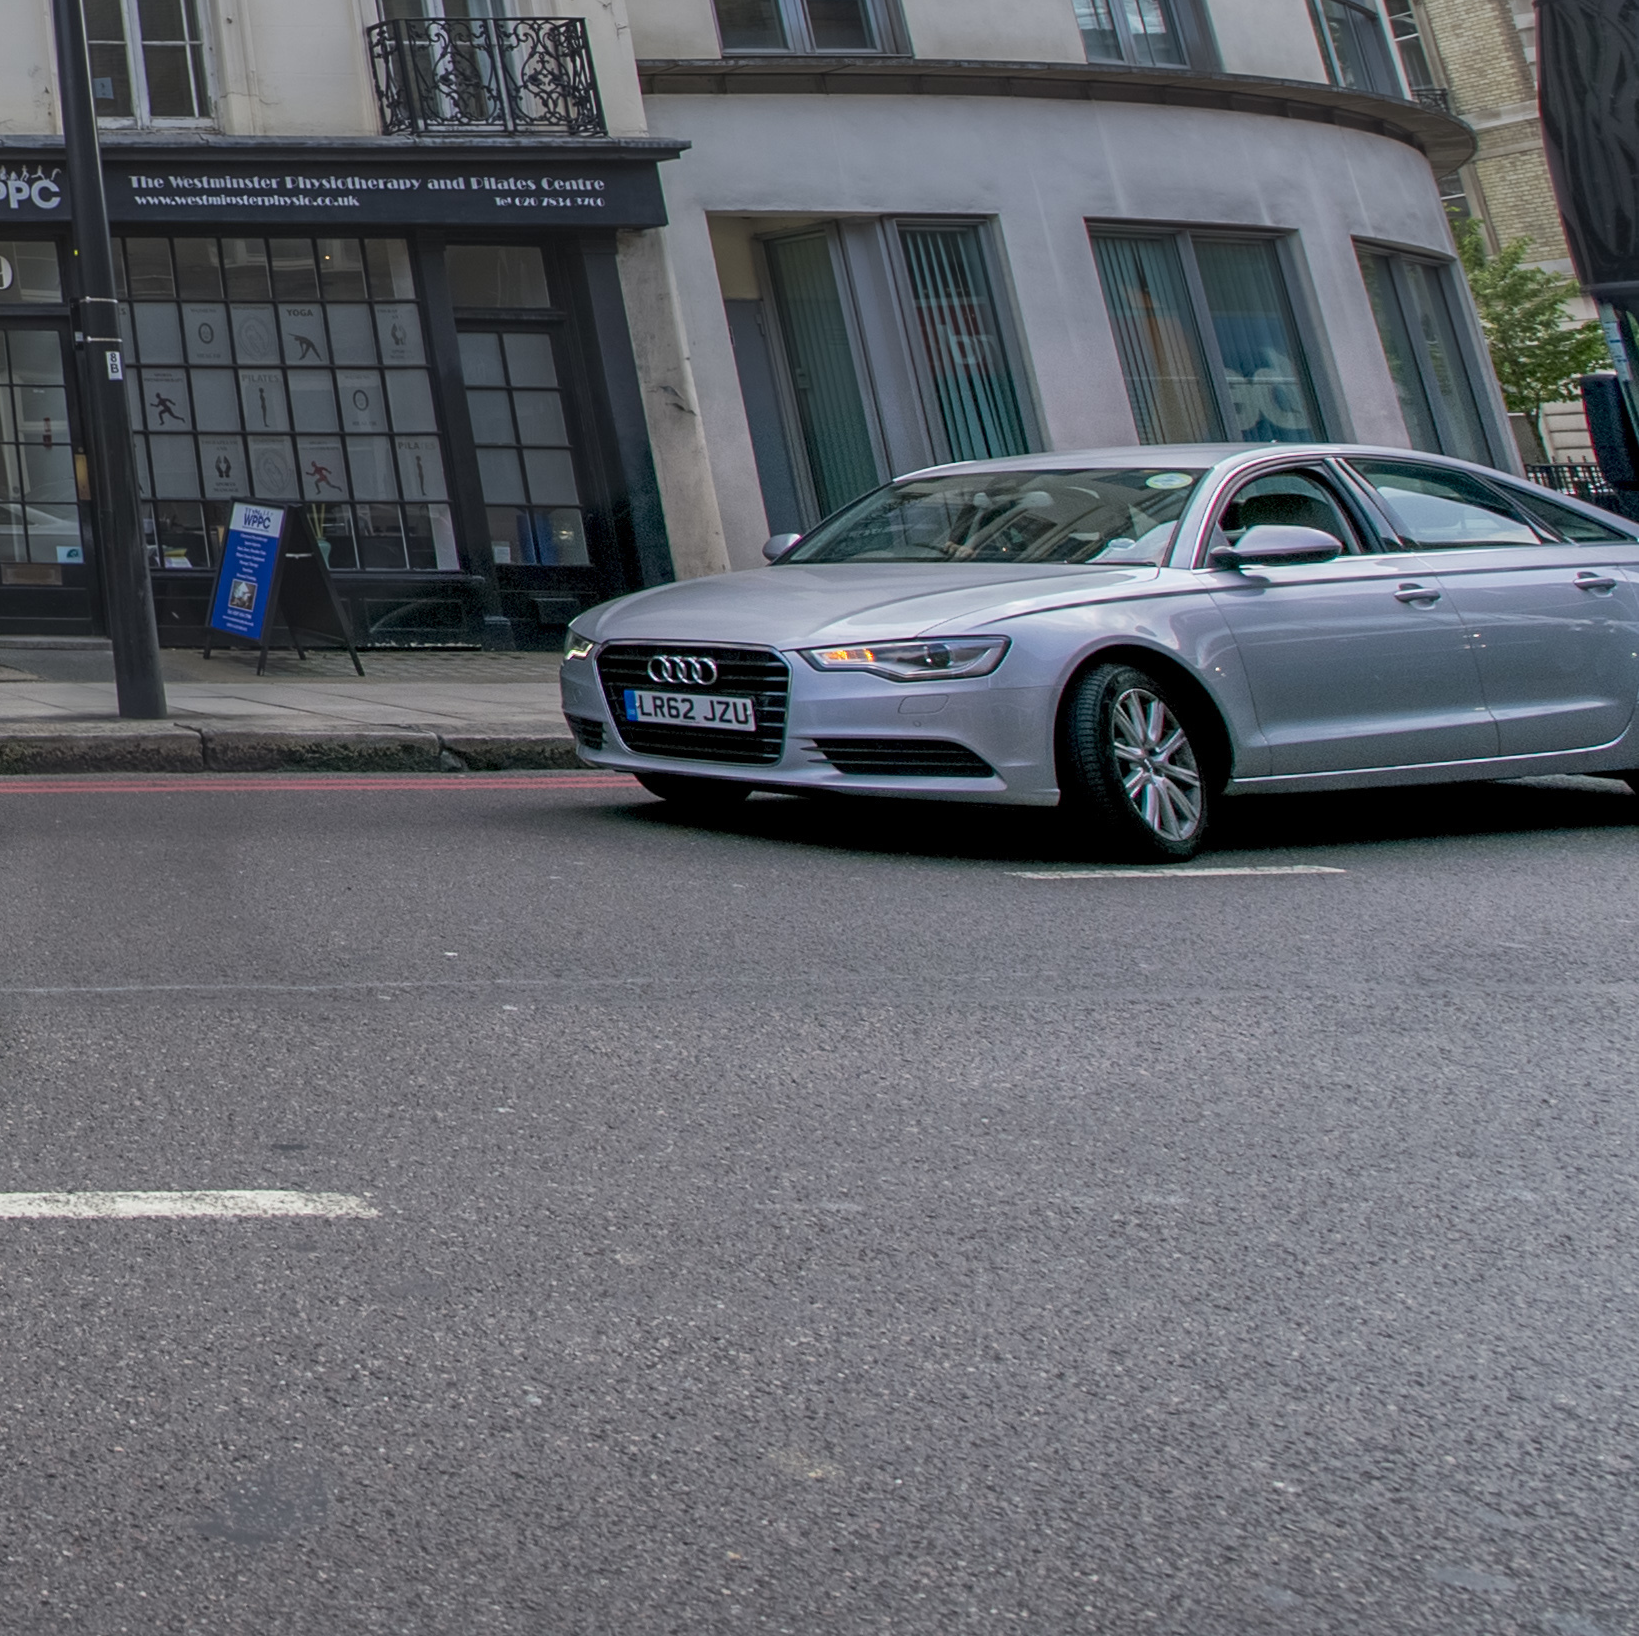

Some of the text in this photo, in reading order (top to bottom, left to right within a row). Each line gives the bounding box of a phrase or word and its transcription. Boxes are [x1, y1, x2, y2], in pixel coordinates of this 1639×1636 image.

[129, 175, 605, 191] The Westminster Physiotherapy and Pilates Centre
[515, 197, 538, 207] 020
[286, 309, 313, 317] YOGA
[242, 374, 279, 383] PILATES
[244, 514, 271, 529] WPPC
[639, 695, 749, 725] LR62 JZU
